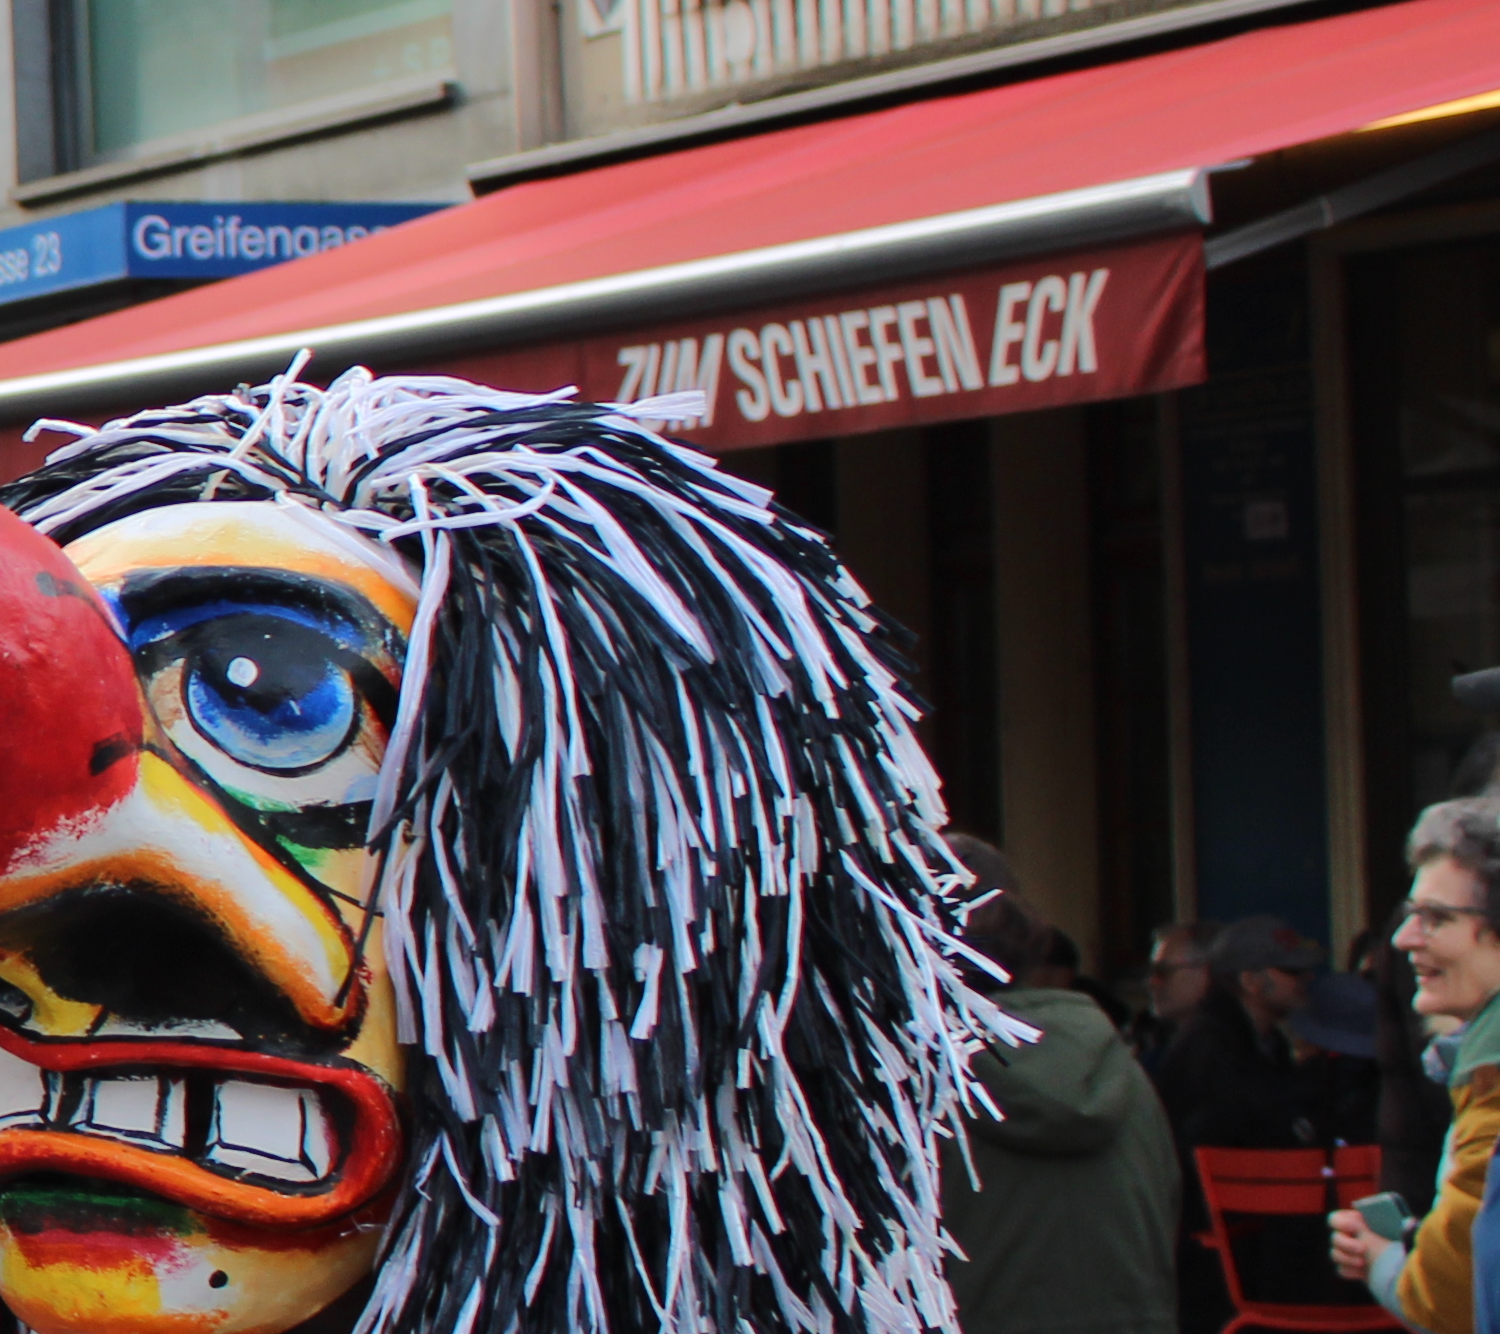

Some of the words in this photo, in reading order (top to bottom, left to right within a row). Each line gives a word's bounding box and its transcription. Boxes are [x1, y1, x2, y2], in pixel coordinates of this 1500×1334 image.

[31, 231, 63, 278] 23
[132, 214, 394, 261] Greifenga
[615, 333, 724, 432] ZUM
[726, 292, 985, 423] SCHIEFEN
[988, 267, 1110, 388] ECK
